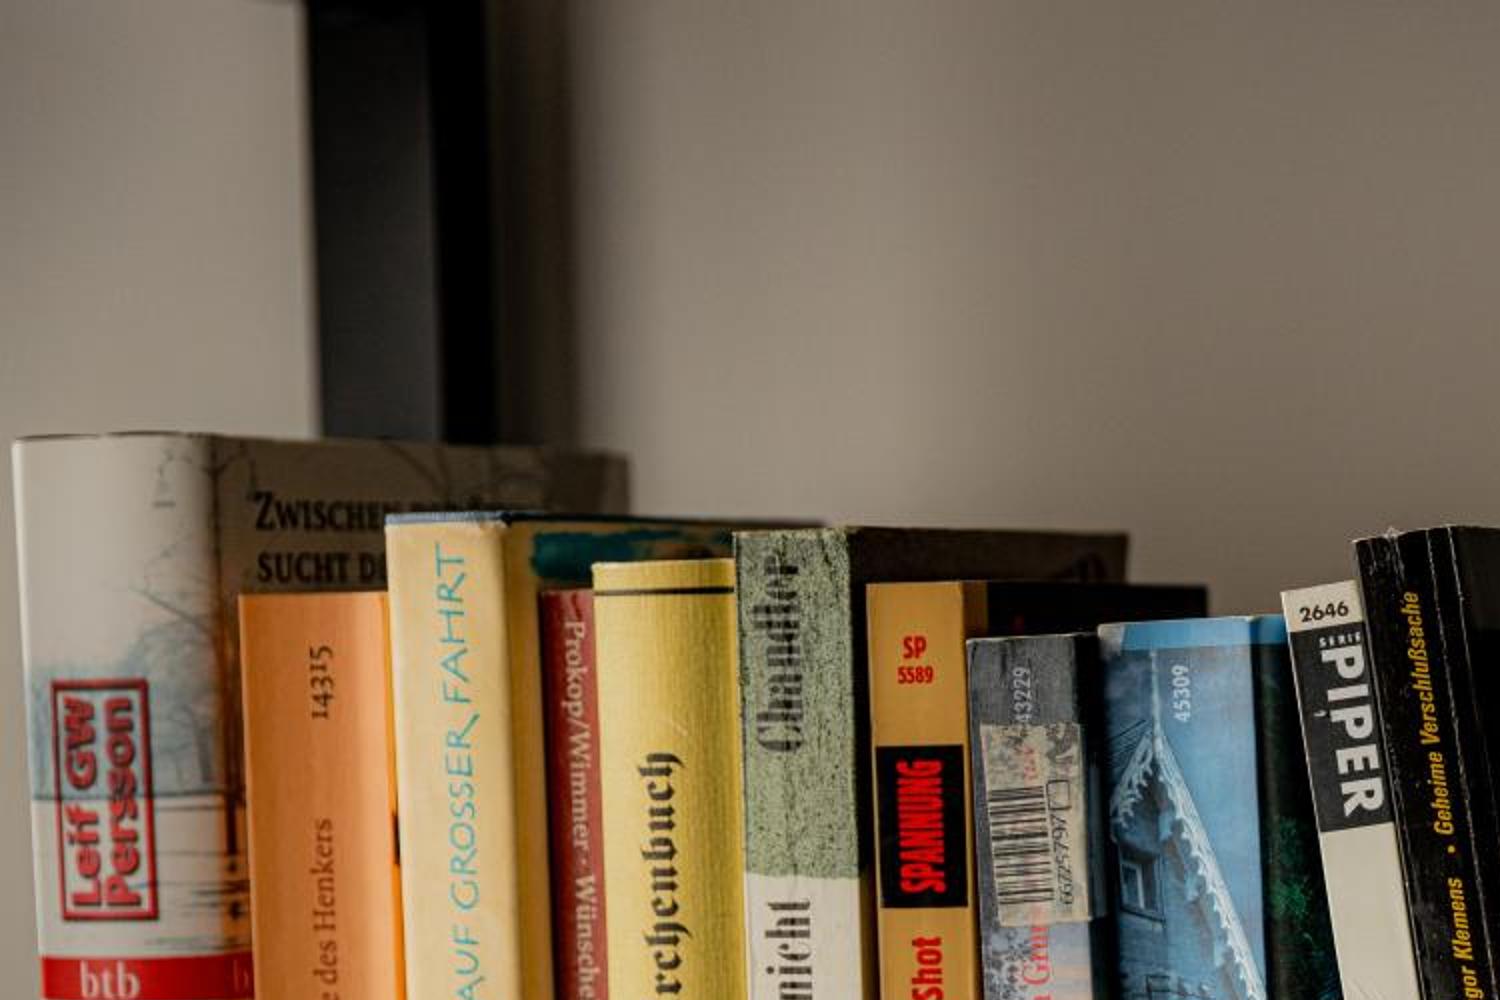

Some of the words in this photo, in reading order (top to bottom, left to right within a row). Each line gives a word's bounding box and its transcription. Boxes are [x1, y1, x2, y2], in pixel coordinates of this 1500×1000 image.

[255, 491, 394, 530] ZWISCHE
[258, 553, 348, 582] SUCHT
[435, 542, 471, 703] FAHRT
[752, 554, 804, 754] Chandler
[902, 636, 927, 658] SP
[1299, 601, 1349, 622] 2646
[309, 645, 334, 720] 14315
[1173, 664, 1192, 723] 45309
[1402, 591, 1441, 745] Verschlußsache
[63, 697, 97, 788] GW
[1322, 646, 1384, 817] PIPER
[105, 697, 143, 907] Persson
[445, 714, 480, 910] GROSSER
[897, 759, 947, 894] SPANNUNG
[1426, 752, 1455, 835] Geheime
[67, 805, 99, 907] Leif
[313, 819, 336, 934] Henkers
[314, 939, 338, 985] des
[1445, 878, 1475, 960] Klemens
[80, 962, 140, 999] btb
